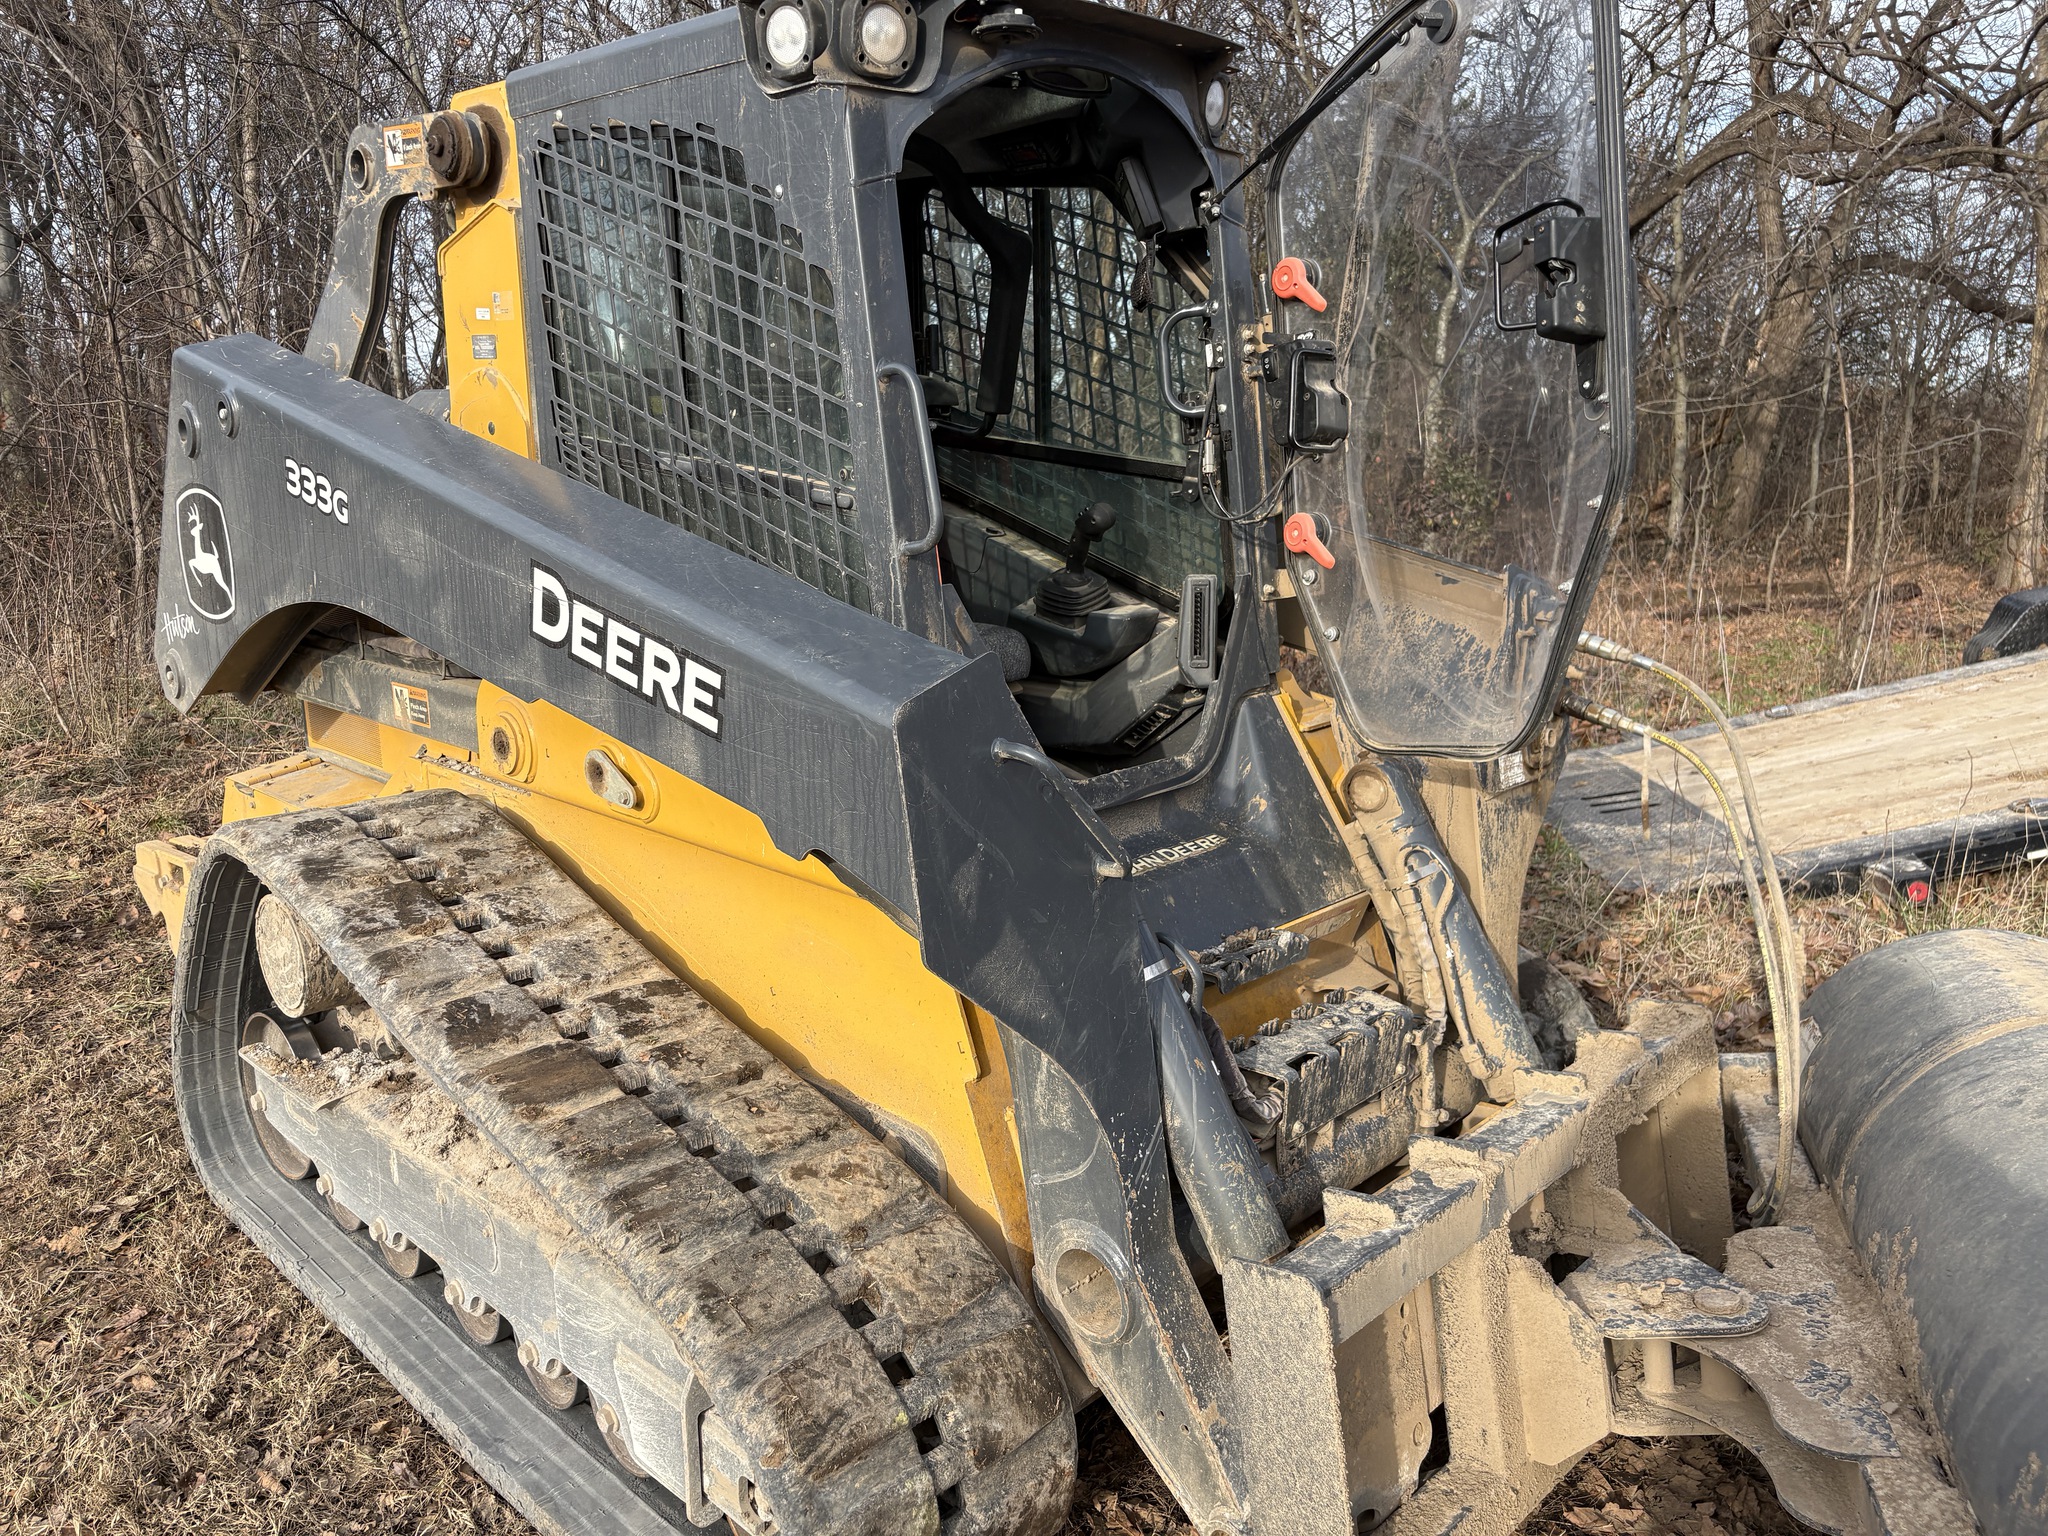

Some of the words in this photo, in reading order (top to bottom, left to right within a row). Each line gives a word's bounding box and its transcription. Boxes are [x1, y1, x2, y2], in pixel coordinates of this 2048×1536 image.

[285, 458, 349, 524] 333G
[532, 566, 722, 734] DEERE
[1131, 854, 1164, 874] HN
[1156, 834, 1224, 861] DEERE
